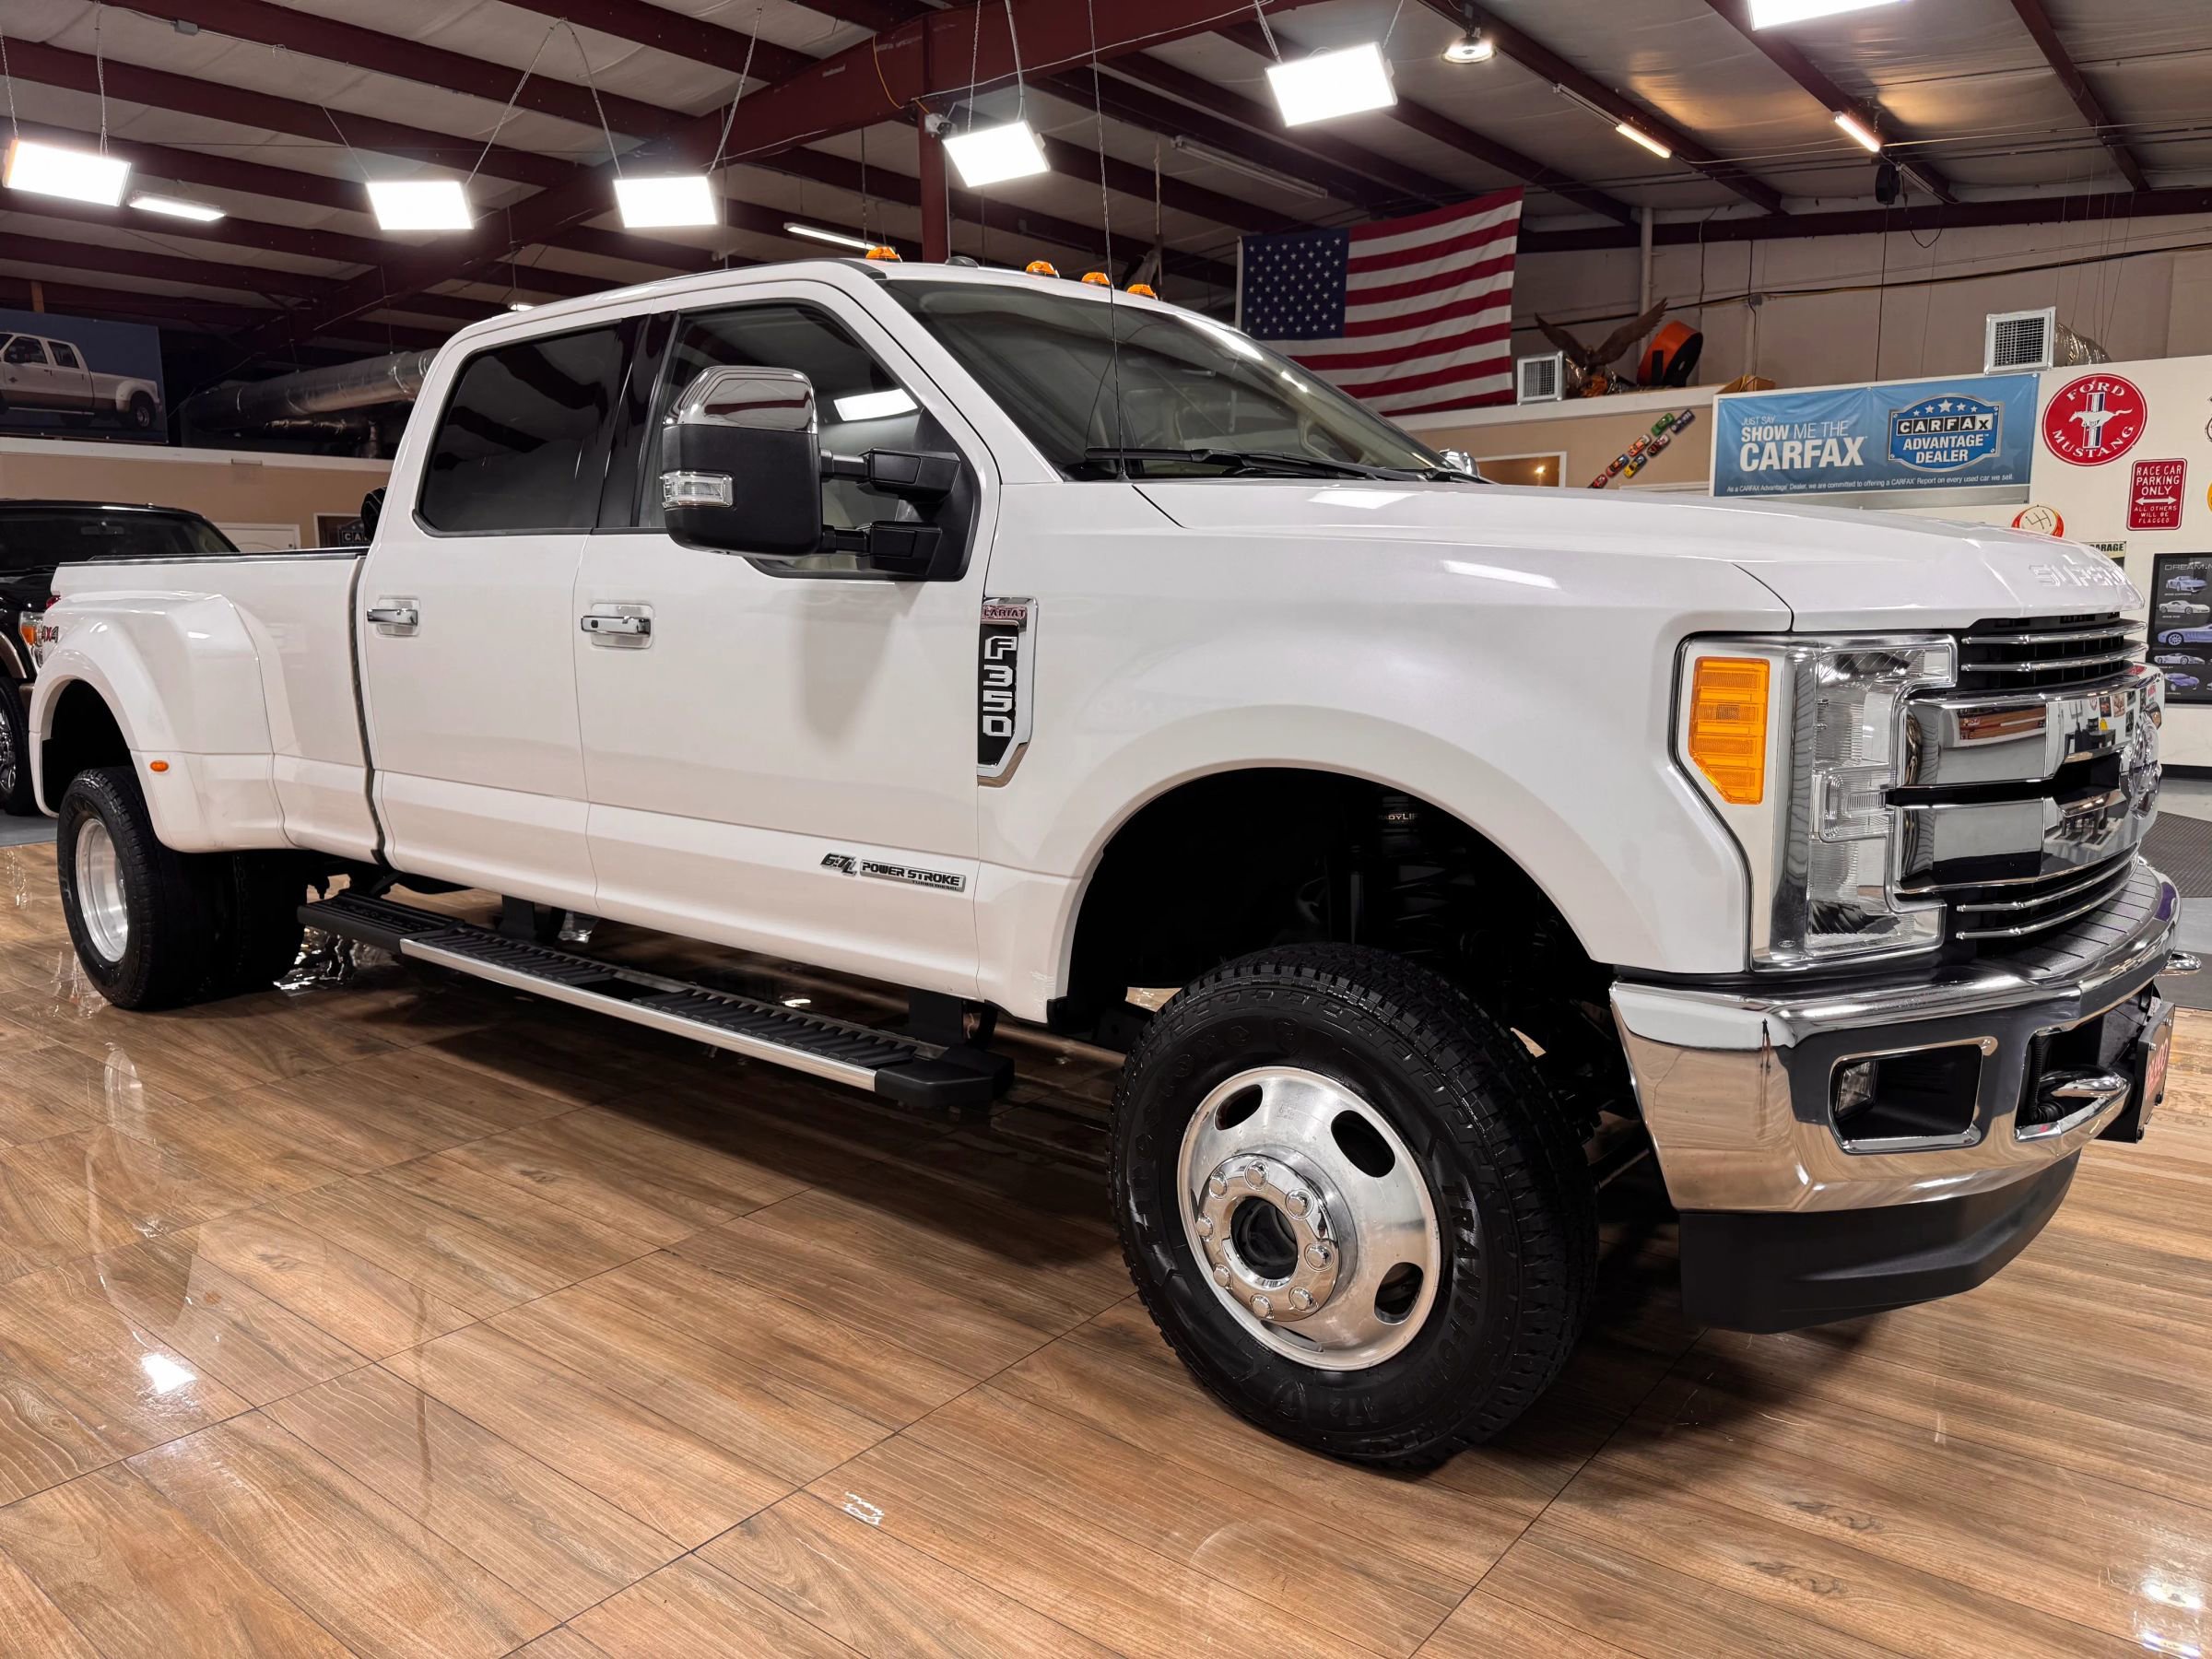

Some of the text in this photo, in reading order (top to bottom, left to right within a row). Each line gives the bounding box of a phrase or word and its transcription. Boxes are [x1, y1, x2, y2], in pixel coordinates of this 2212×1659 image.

[2066, 381, 2125, 402] FORD
[1741, 415, 1776, 426] JUST SAY
[1900, 418, 1989, 433] CARFAX
[1741, 419, 1849, 442] SHOW ME THE
[1902, 433, 1983, 451] ADVANTAGE
[2052, 424, 2136, 458] MUSTANG
[1739, 436, 1865, 472] CARFAX
[1915, 449, 1969, 464] DEALER
[2136, 465, 2182, 476] RACE CAR
[1864, 479, 1885, 488] offering
[1917, 477, 1936, 487] Report
[1947, 477, 1962, 485] every
[2136, 476, 2180, 487] PARKING
[2141, 486, 2172, 496] ONLY
[982, 606, 1027, 618] LARIAT
[982, 636, 1018, 737] F350
[862, 862, 960, 887] POWER STROKE
